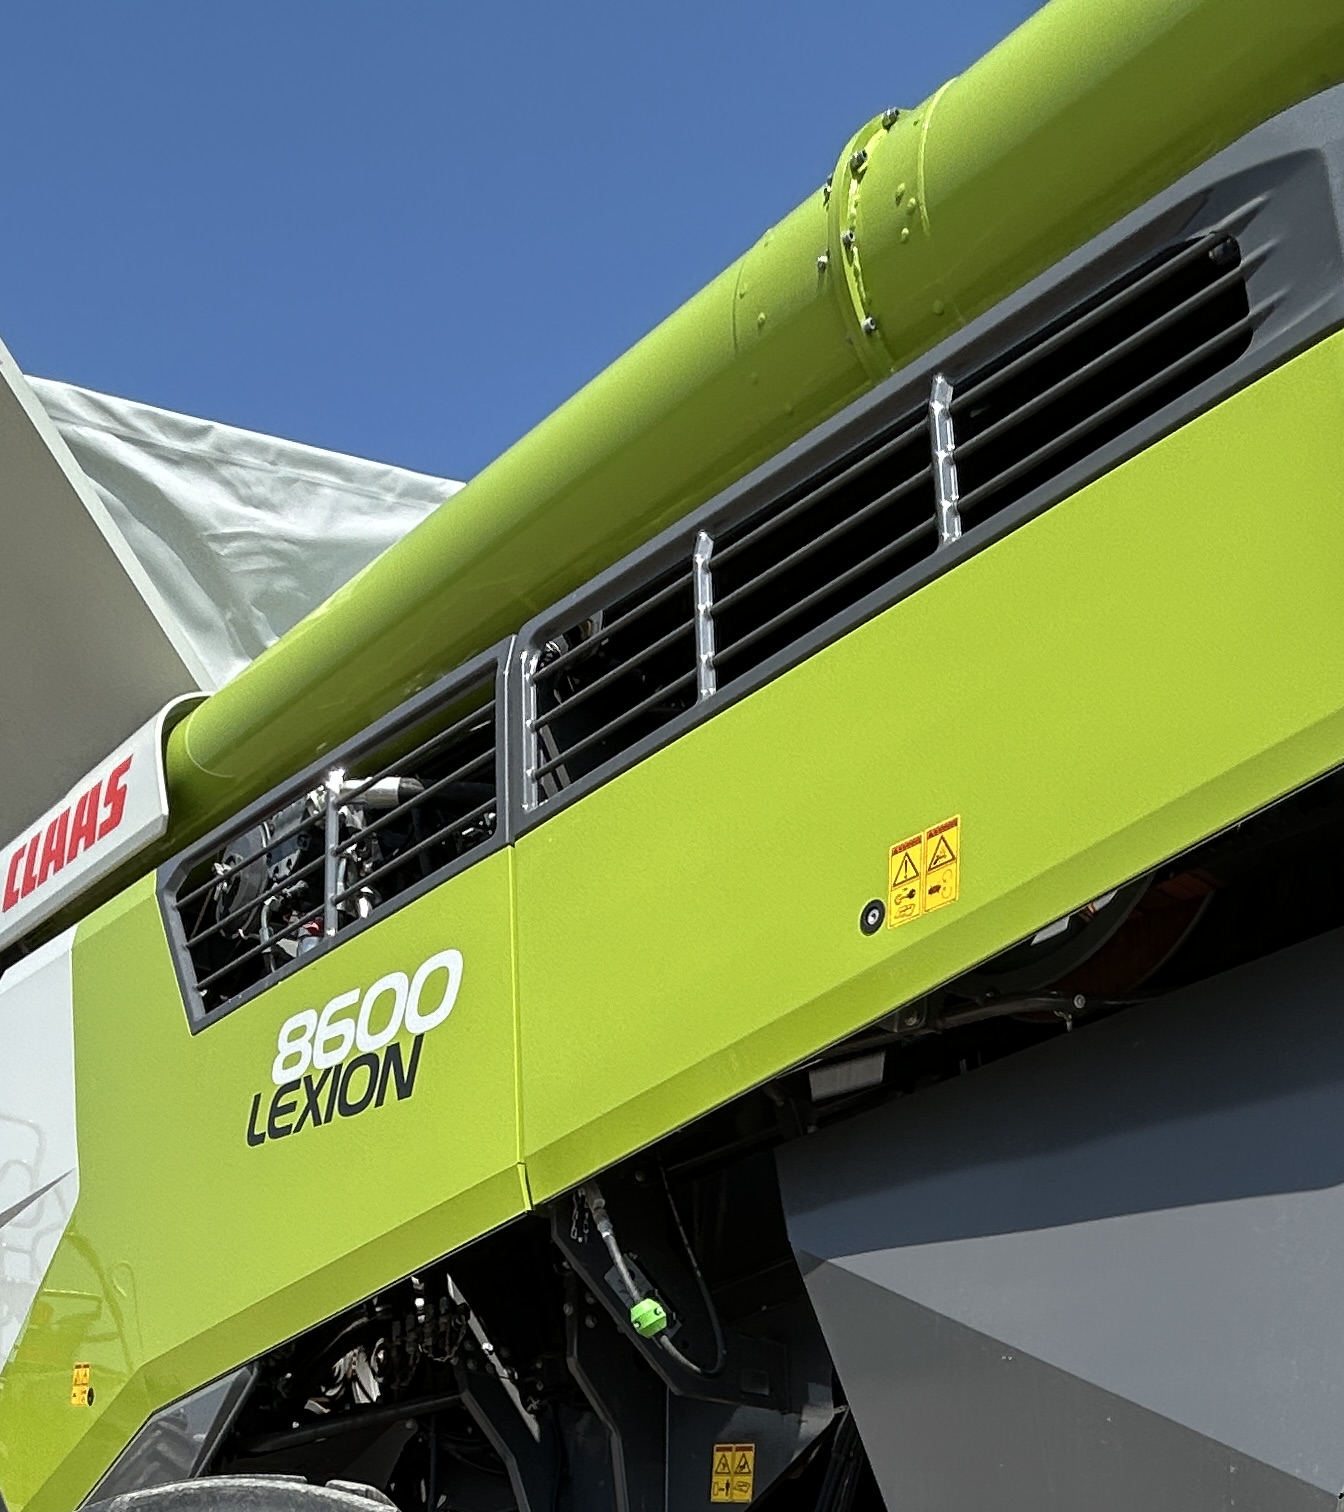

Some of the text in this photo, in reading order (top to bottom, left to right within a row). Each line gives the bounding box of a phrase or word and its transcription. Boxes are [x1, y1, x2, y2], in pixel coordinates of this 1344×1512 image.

[2, 755, 132, 912] CLAAS
[271, 949, 464, 1086] 8600
[246, 1033, 425, 1148] LEXION
